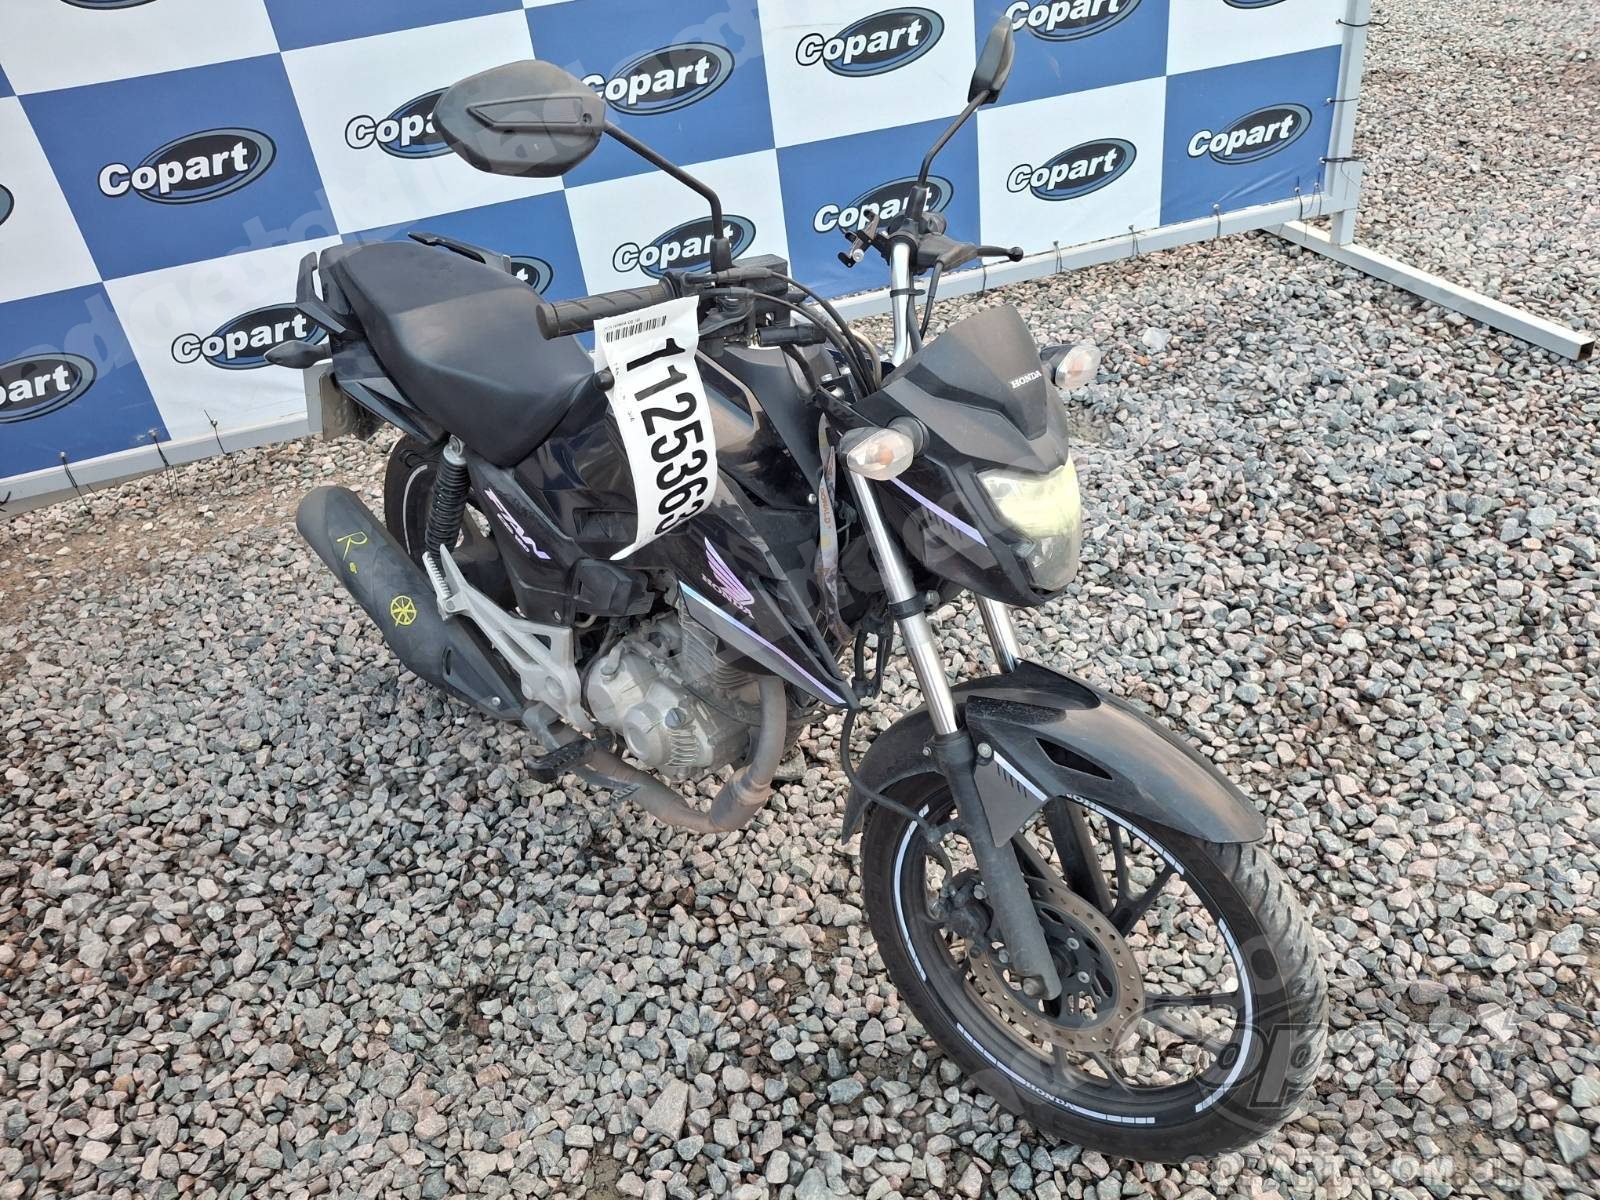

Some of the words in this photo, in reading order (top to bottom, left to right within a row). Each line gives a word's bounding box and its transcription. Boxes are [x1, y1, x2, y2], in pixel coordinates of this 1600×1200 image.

[796, 18, 924, 66] Copart
[1187, 113, 1294, 159] Copart
[99, 141, 248, 197] Copart
[1007, 148, 1118, 193] Copart
[172, 313, 308, 364] Copart
[1010, 370, 1042, 389] HONDA
[626, 338, 708, 535] 1125363
[701, 573, 755, 620] HONDA
[1025, 1081, 1075, 1110] HONDA
